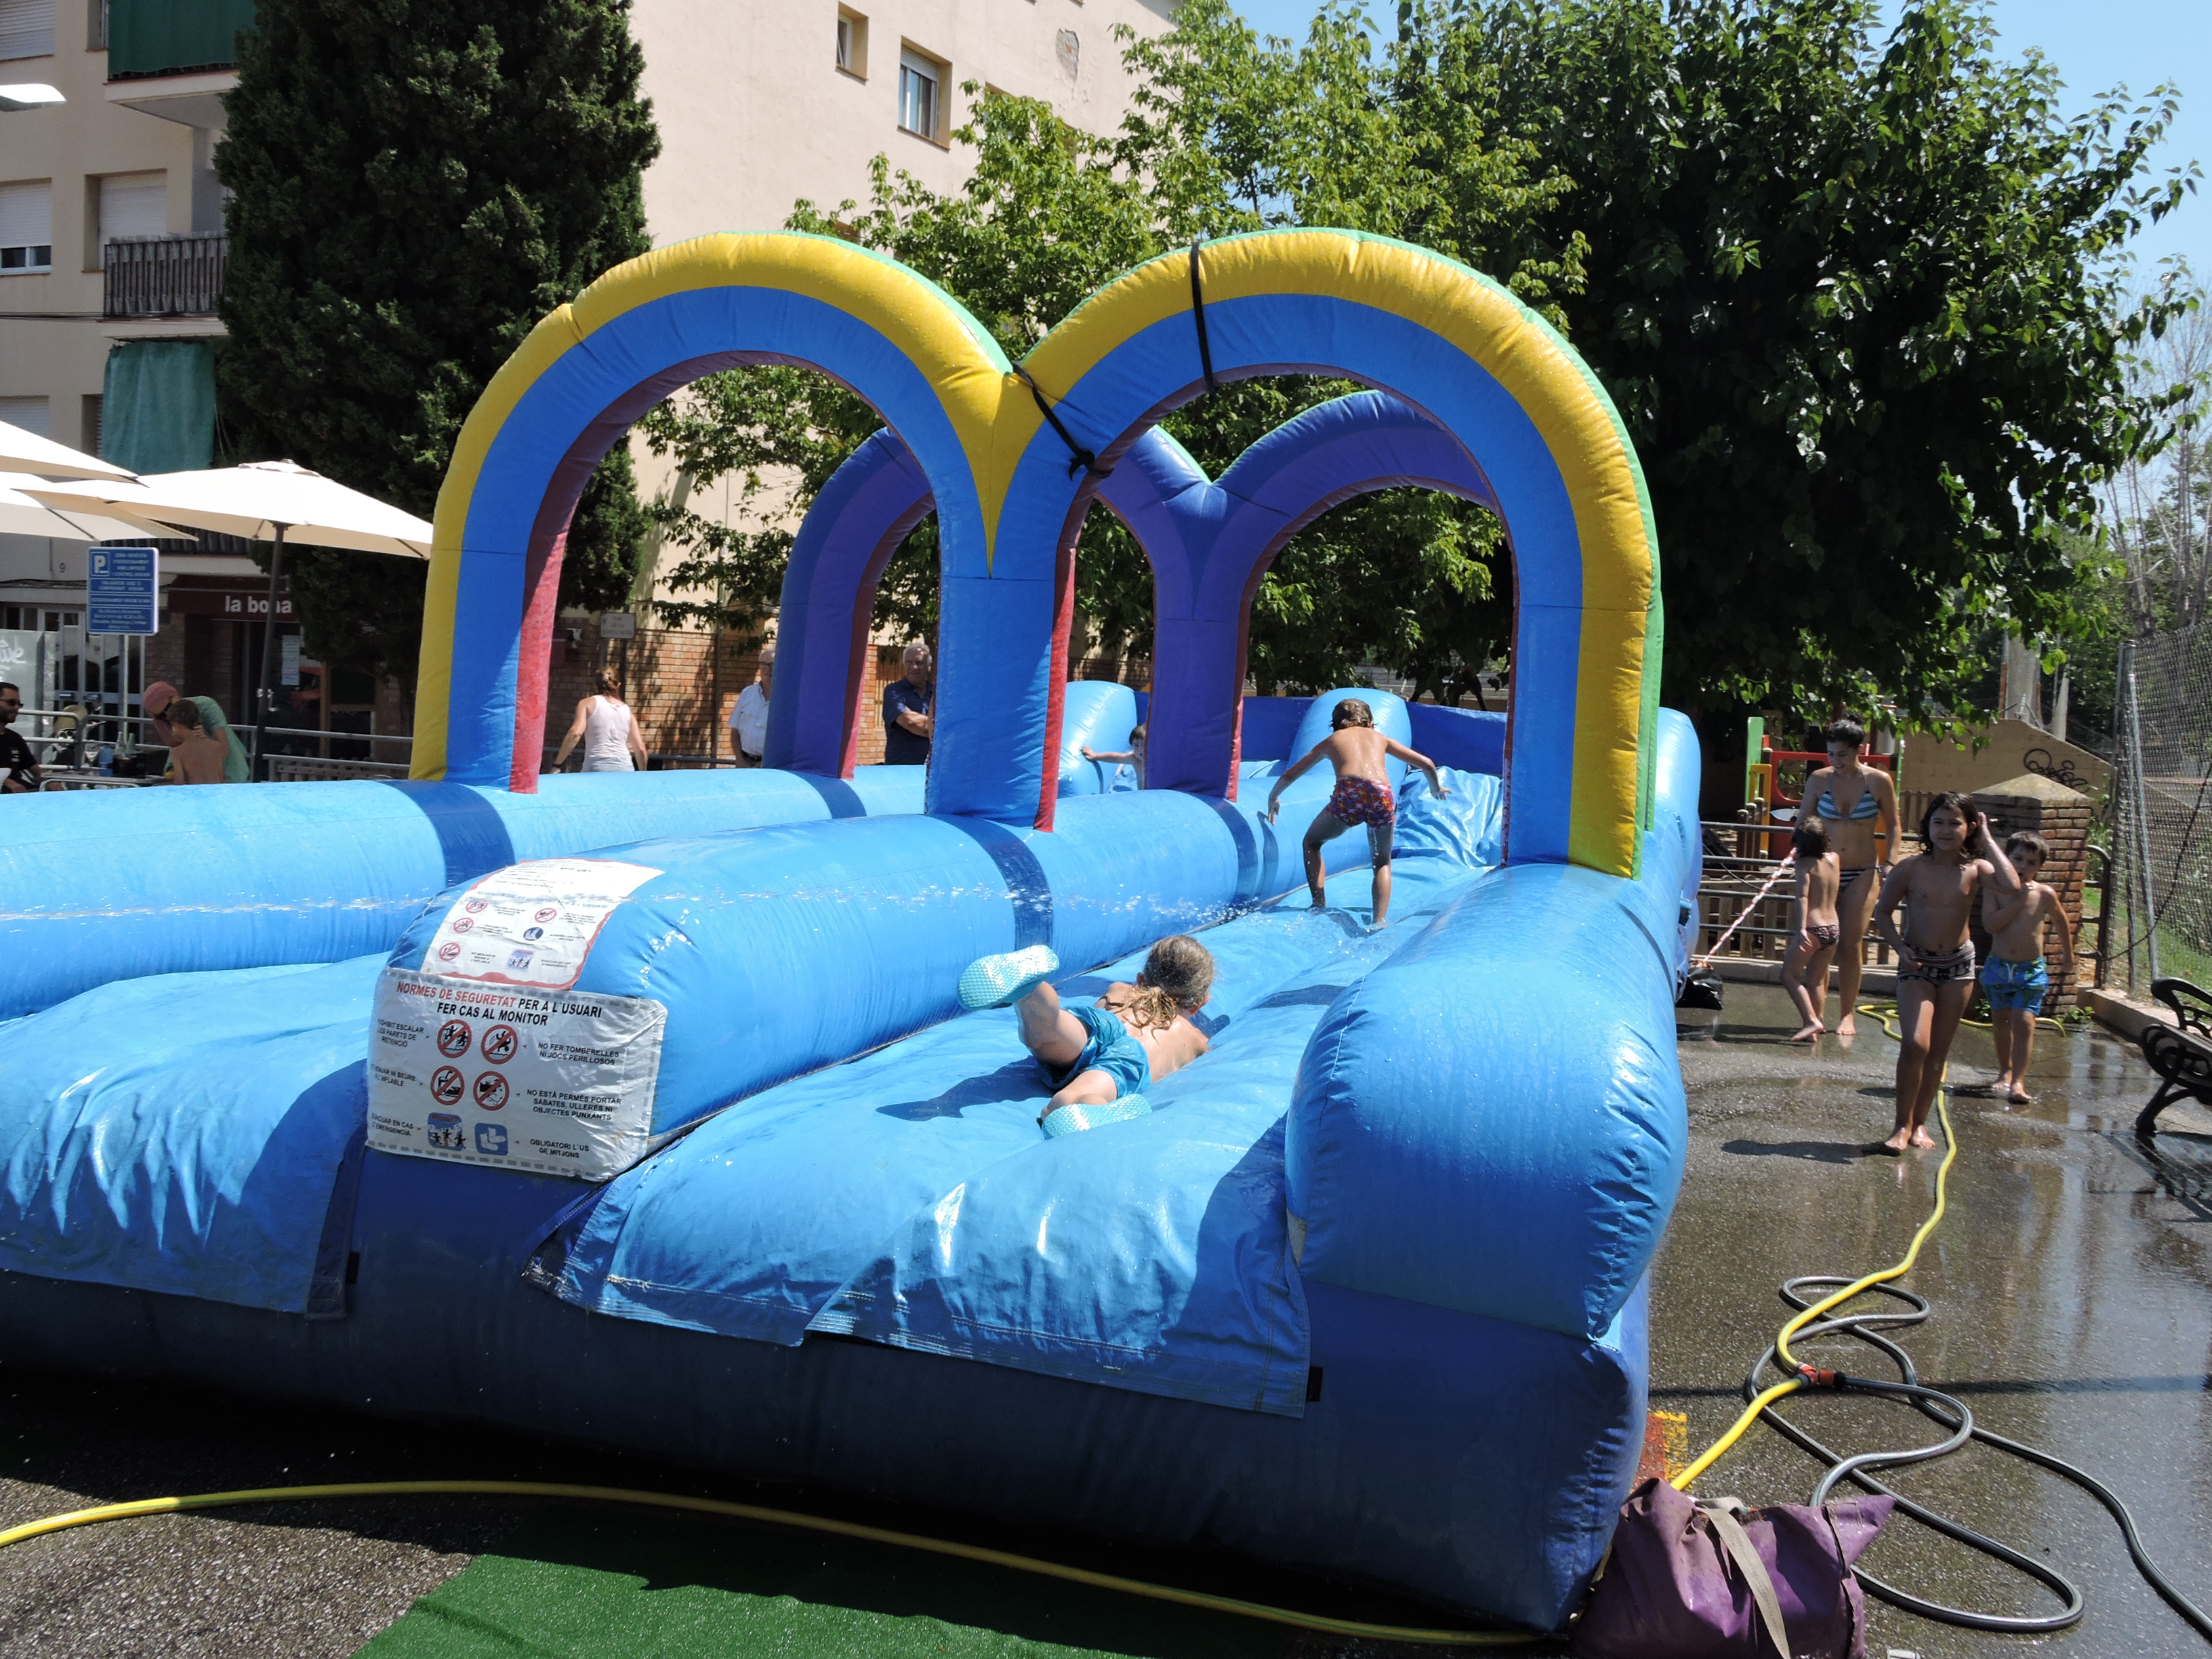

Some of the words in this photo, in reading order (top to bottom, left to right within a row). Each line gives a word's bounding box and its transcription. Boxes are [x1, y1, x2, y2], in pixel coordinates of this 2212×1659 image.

[59, 562, 66, 573] 9
[225, 596, 241, 612] la
[396, 981, 437, 998] NORMES
[438, 988, 452, 1000] DE
[454, 990, 517, 1008] SEGURETAT
[518, 998, 539, 1010] PER
[541, 1000, 549, 1012] A
[436, 1002, 457, 1016] FER
[459, 1004, 480, 1018] CAS
[481, 1007, 496, 1020] AL
[497, 1010, 548, 1026] MONITOR
[396, 1023, 425, 1033] ESCALAR
[386, 1029, 407, 1040] PARETS
[538, 1042, 549, 1050] NO
[550, 1044, 565, 1052] FER
[566, 1045, 619, 1058] TOMBERELLES
[548, 1051, 567, 1061] JOCS
[569, 1054, 615, 1065] PERILLOSOS
[397, 1071, 416, 1082] BEURE
[533, 1098, 567, 1109] SABATES,
[569, 1102, 603, 1111] ULLERES
[590, 1097, 622, 1105] PORTAR
[533, 1106, 570, 1117] OBJECTES
[571, 1111, 612, 1120] PUNXANTS
[401, 1121, 414, 1129] CAS
[530, 1139, 571, 1150] OBLIGATORI
[550, 1149, 580, 1159] MITJONS
